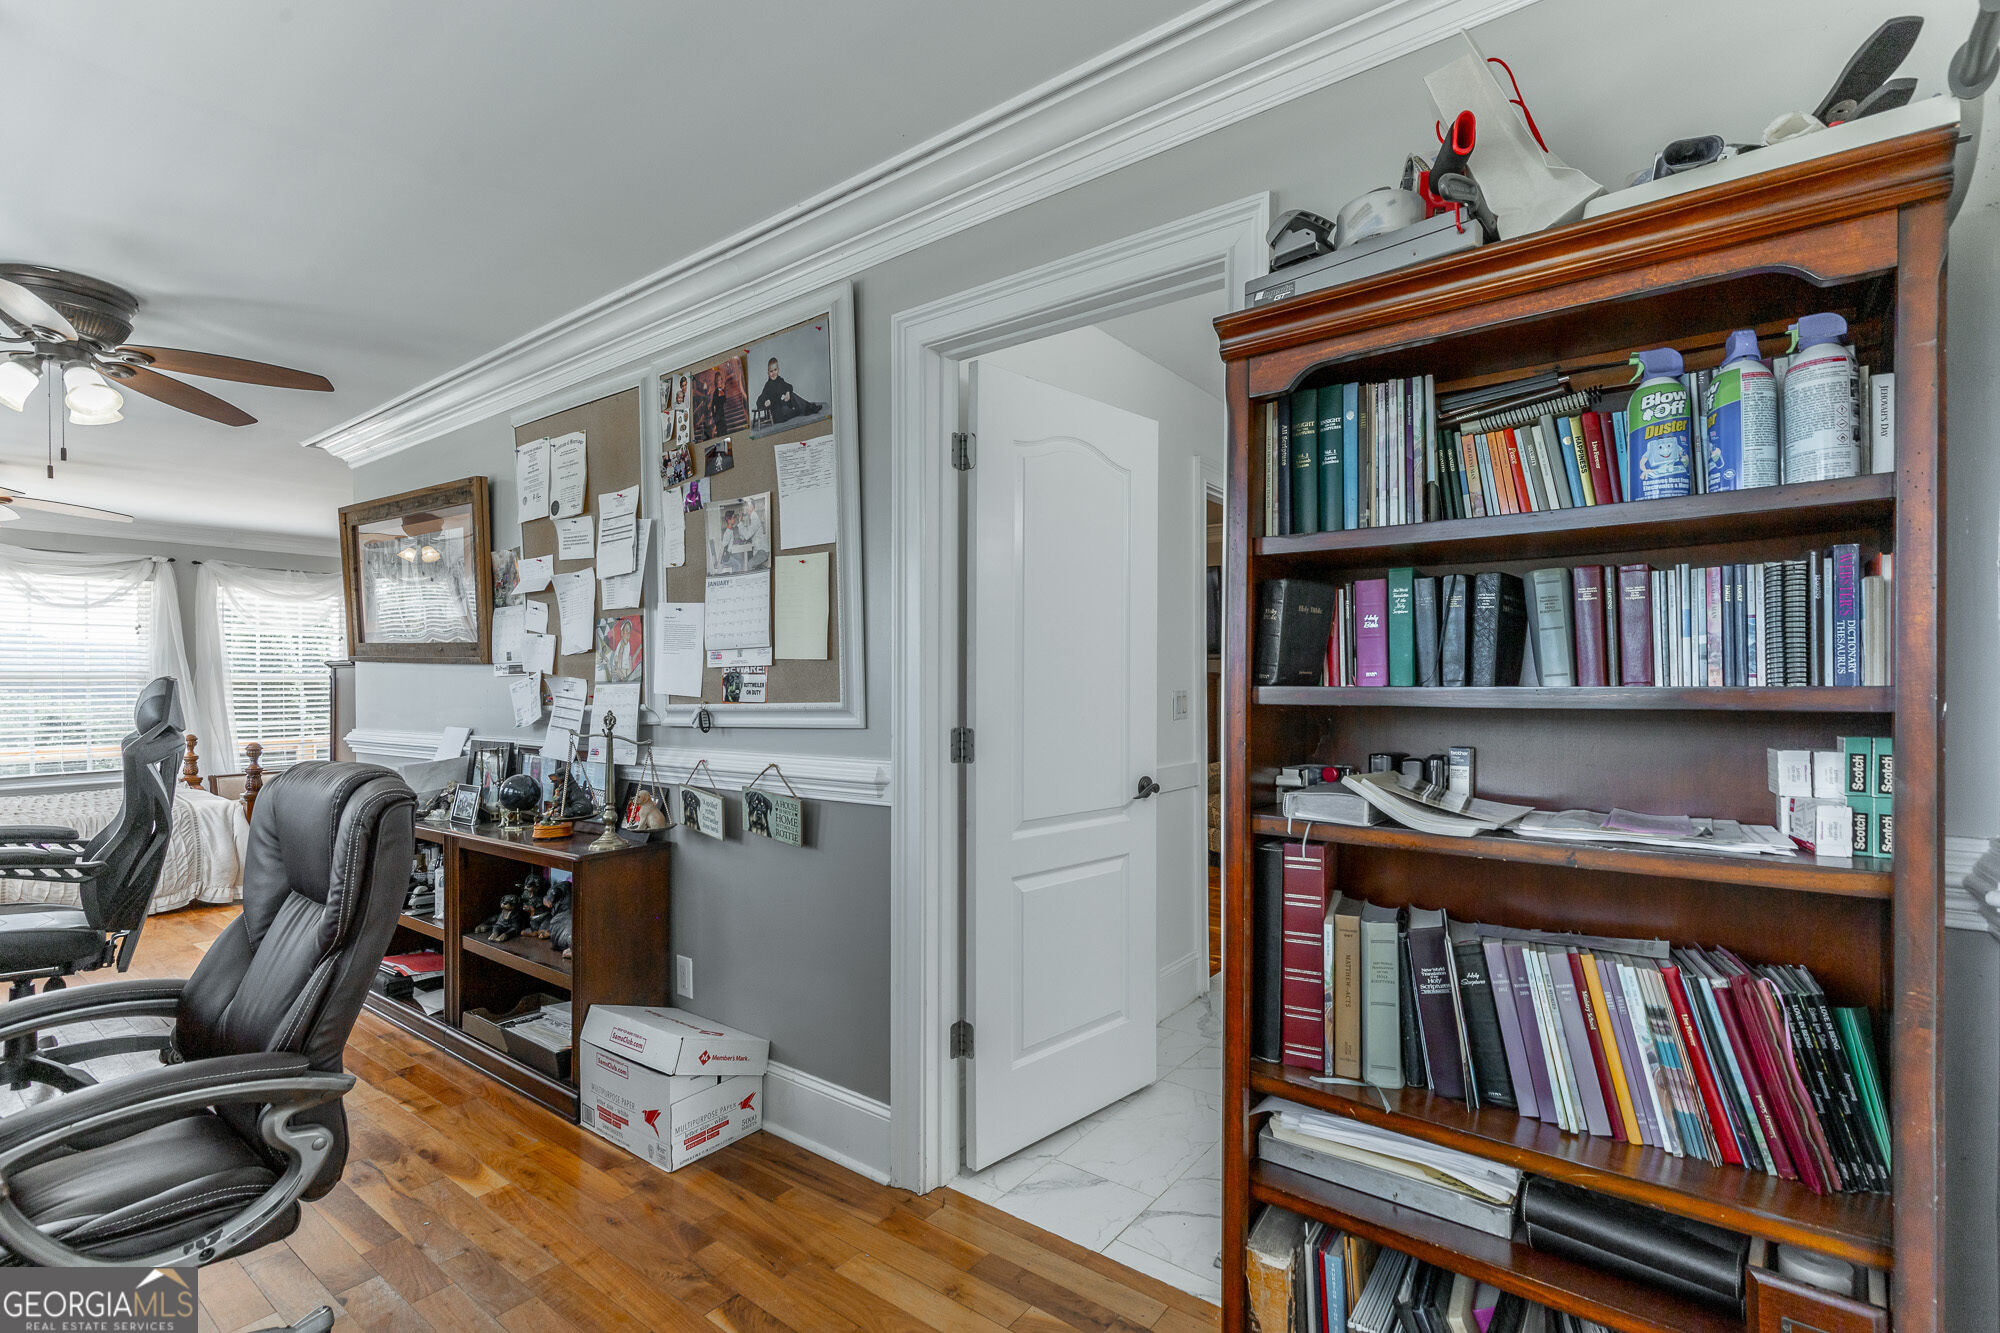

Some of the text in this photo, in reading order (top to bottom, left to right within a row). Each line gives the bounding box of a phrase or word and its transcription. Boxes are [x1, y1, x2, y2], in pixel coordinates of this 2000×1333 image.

[1641, 391, 1686, 410] Blow
[1654, 401, 1685, 418] Off
[1879, 385, 1889, 438] JEHOVAH'S DAY
[1320, 418, 1342, 426] INSIGHT
[1645, 420, 1688, 440] Duster
[1508, 448, 1518, 465] Peace
[1574, 436, 1588, 474] HAPPINESS
[1838, 552, 1853, 616] WEBSTER'S
[1298, 604, 1323, 614] Holy Bible
[1364, 614, 1379, 623] Holy
[1364, 620, 1378, 628] Bible
[1836, 620, 1846, 674] THESAURUS
[1848, 620, 1856, 674] DICTIONARY
[1852, 755, 1864, 790] Scotch
[1881, 756, 1892, 792] Scotch
[776, 813, 798, 827] HOME
[779, 801, 798, 812] HOUSE
[775, 829, 798, 842] ROTTIE
[776, 823, 794, 832] WITHOUT
[1854, 814, 1866, 850] Scotch
[1882, 816, 1892, 852] Scotch
[1460, 978, 1486, 986] Scriptures
[1581, 990, 1596, 1030] Ministry School
[1681, 1014, 1696, 1046] Live Forever
[1792, 1005, 1803, 1021] LOVE
[1800, 1029, 1813, 1049] BEING
[1820, 1006, 1841, 1050] LOVE IN BEING
[591, 1082, 636, 1110] MULTIPURPOSE PAPER
[675, 1103, 737, 1134] MULTIPURPOSE PAPER
[684, 1128, 698, 1137] letter
[714, 1115, 729, 1126] white
